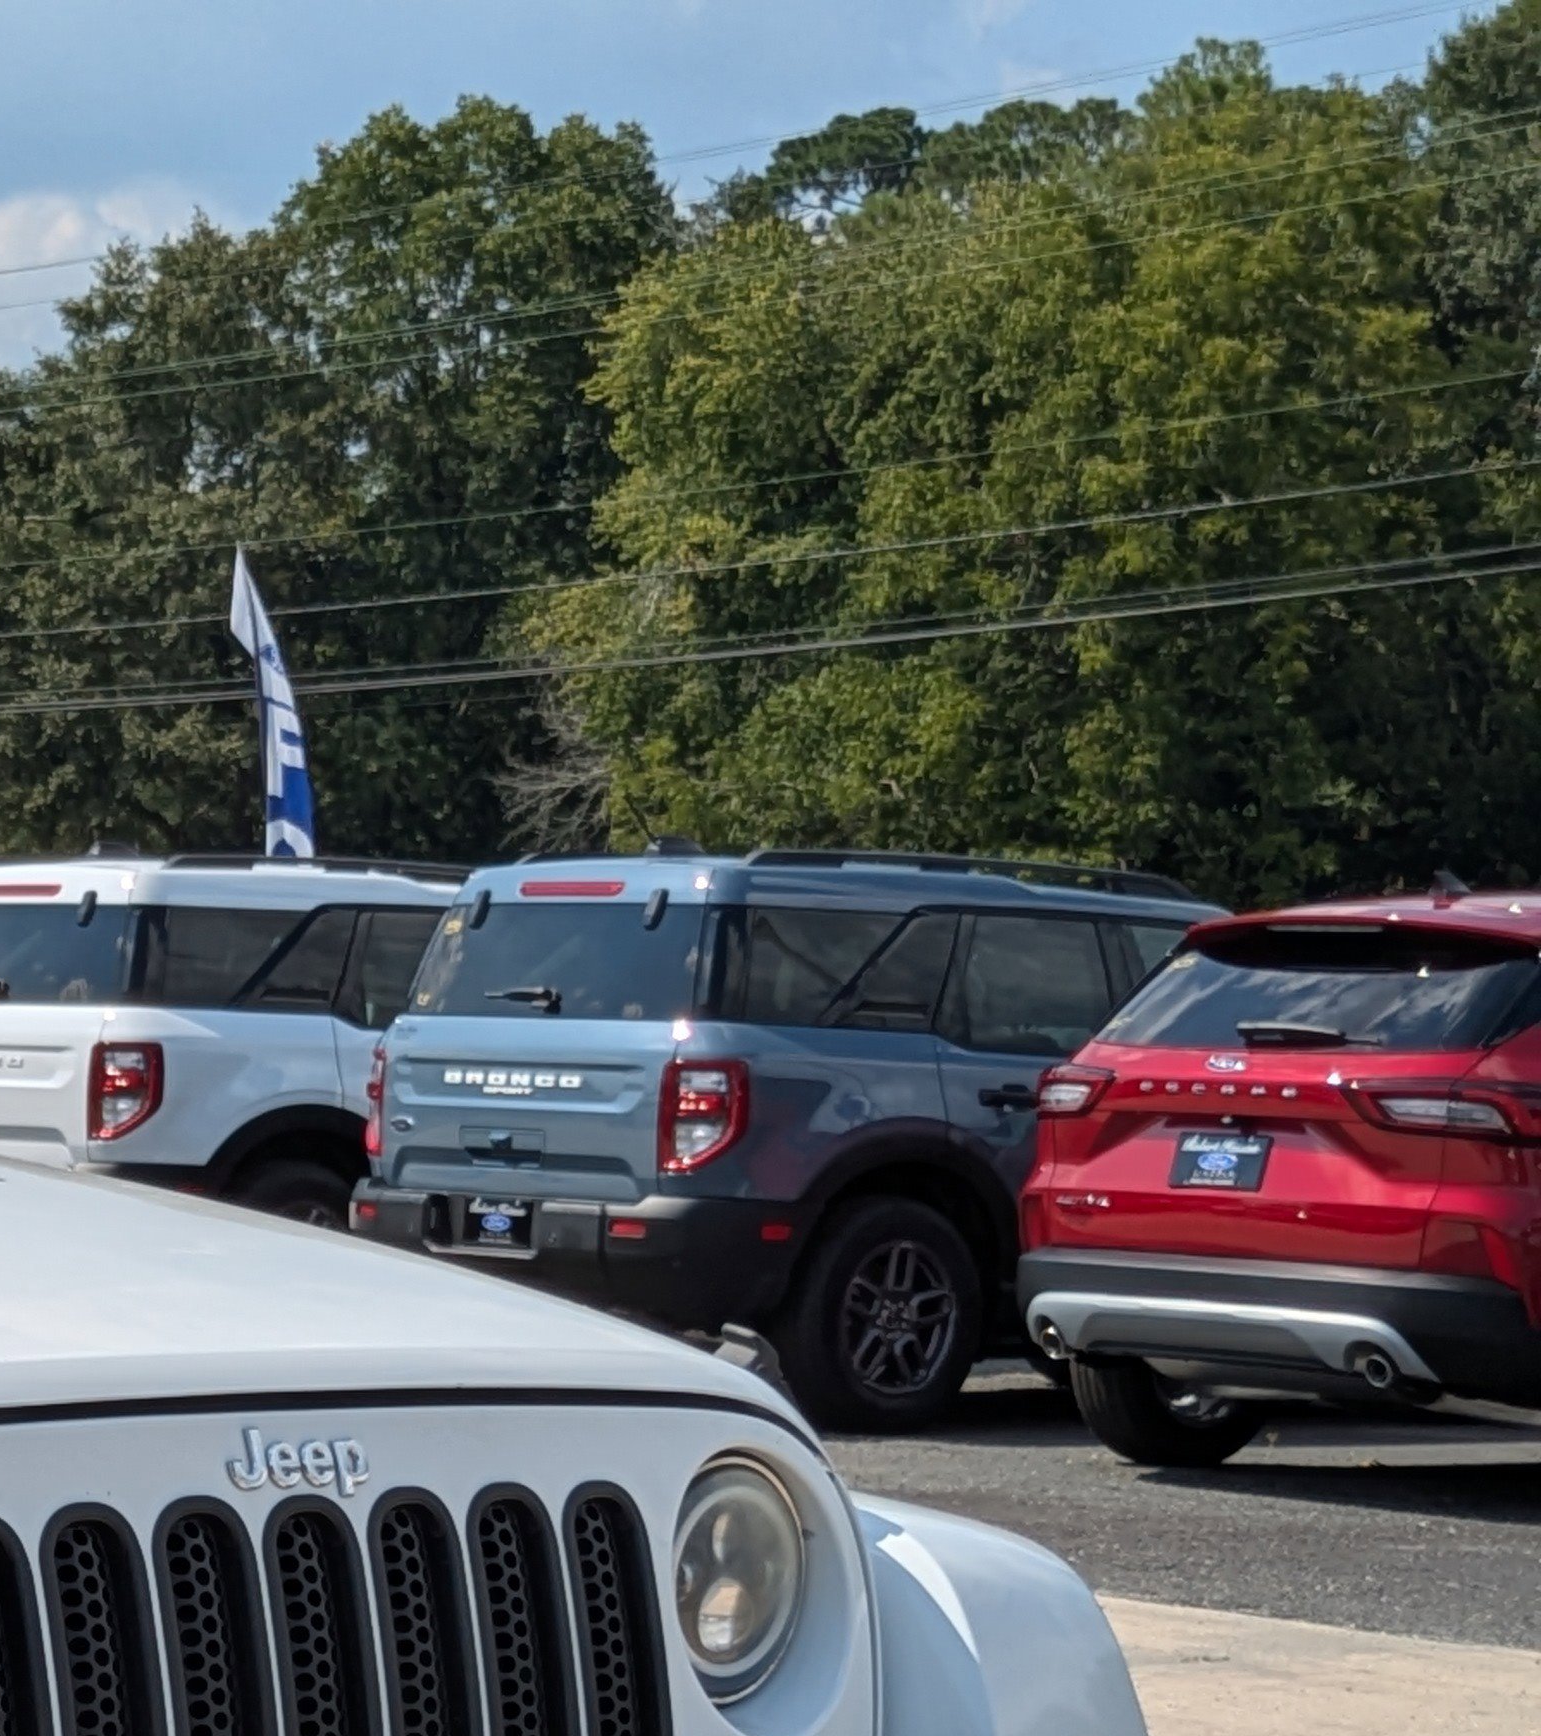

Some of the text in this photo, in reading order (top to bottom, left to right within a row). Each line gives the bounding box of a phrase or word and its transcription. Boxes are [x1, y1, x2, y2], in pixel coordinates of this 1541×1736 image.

[443, 1069, 584, 1088] BRONCO
[482, 1086, 534, 1095] SPORT
[226, 1426, 369, 1496] Jeep
